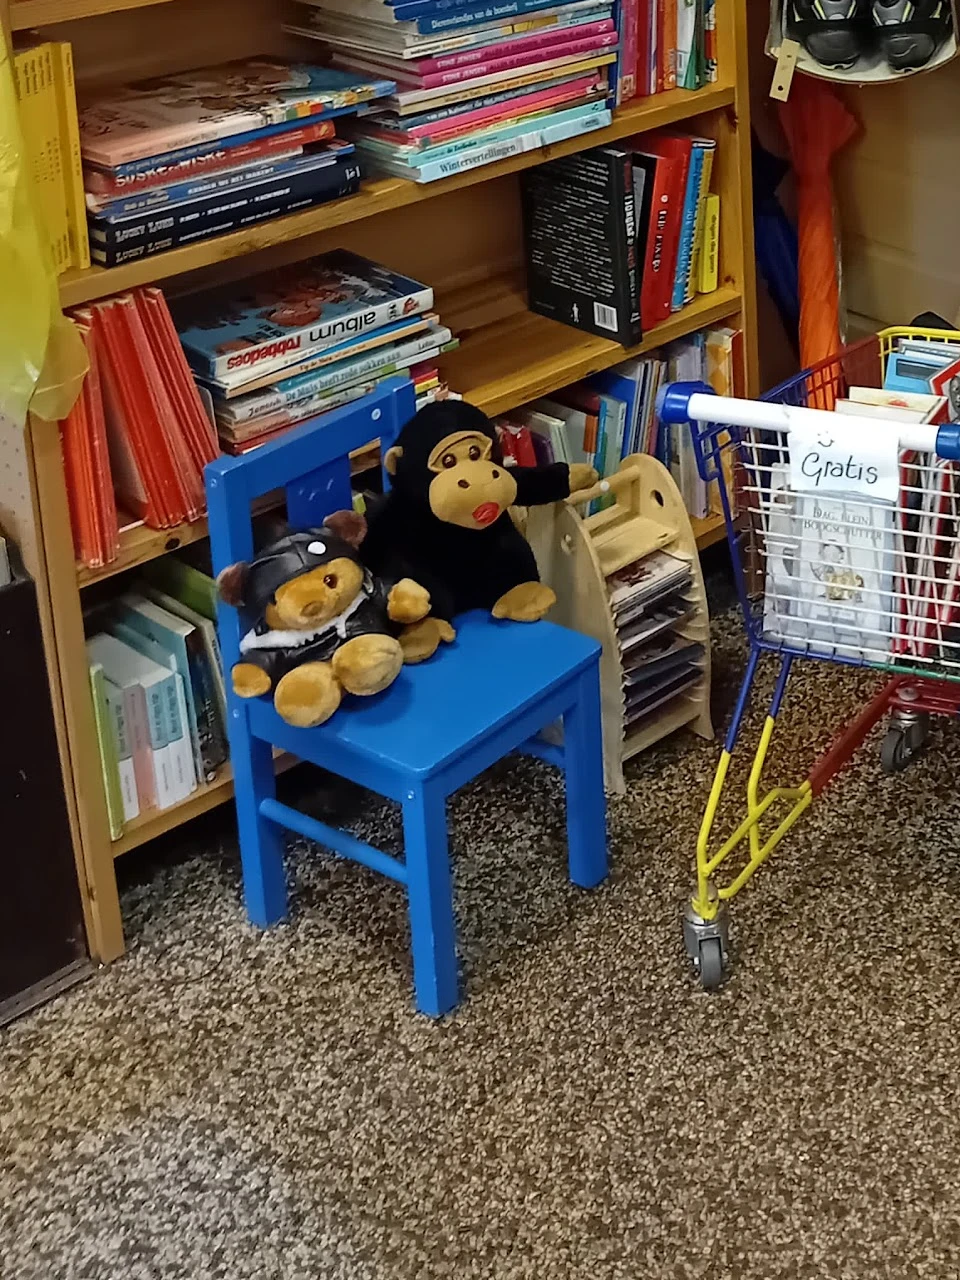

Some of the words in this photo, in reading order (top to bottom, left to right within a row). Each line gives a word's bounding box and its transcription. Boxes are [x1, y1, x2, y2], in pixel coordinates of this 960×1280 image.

[308, 311, 376, 342] album
[226, 335, 301, 370] robbedoes
[801, 451, 878, 487] Gratis
